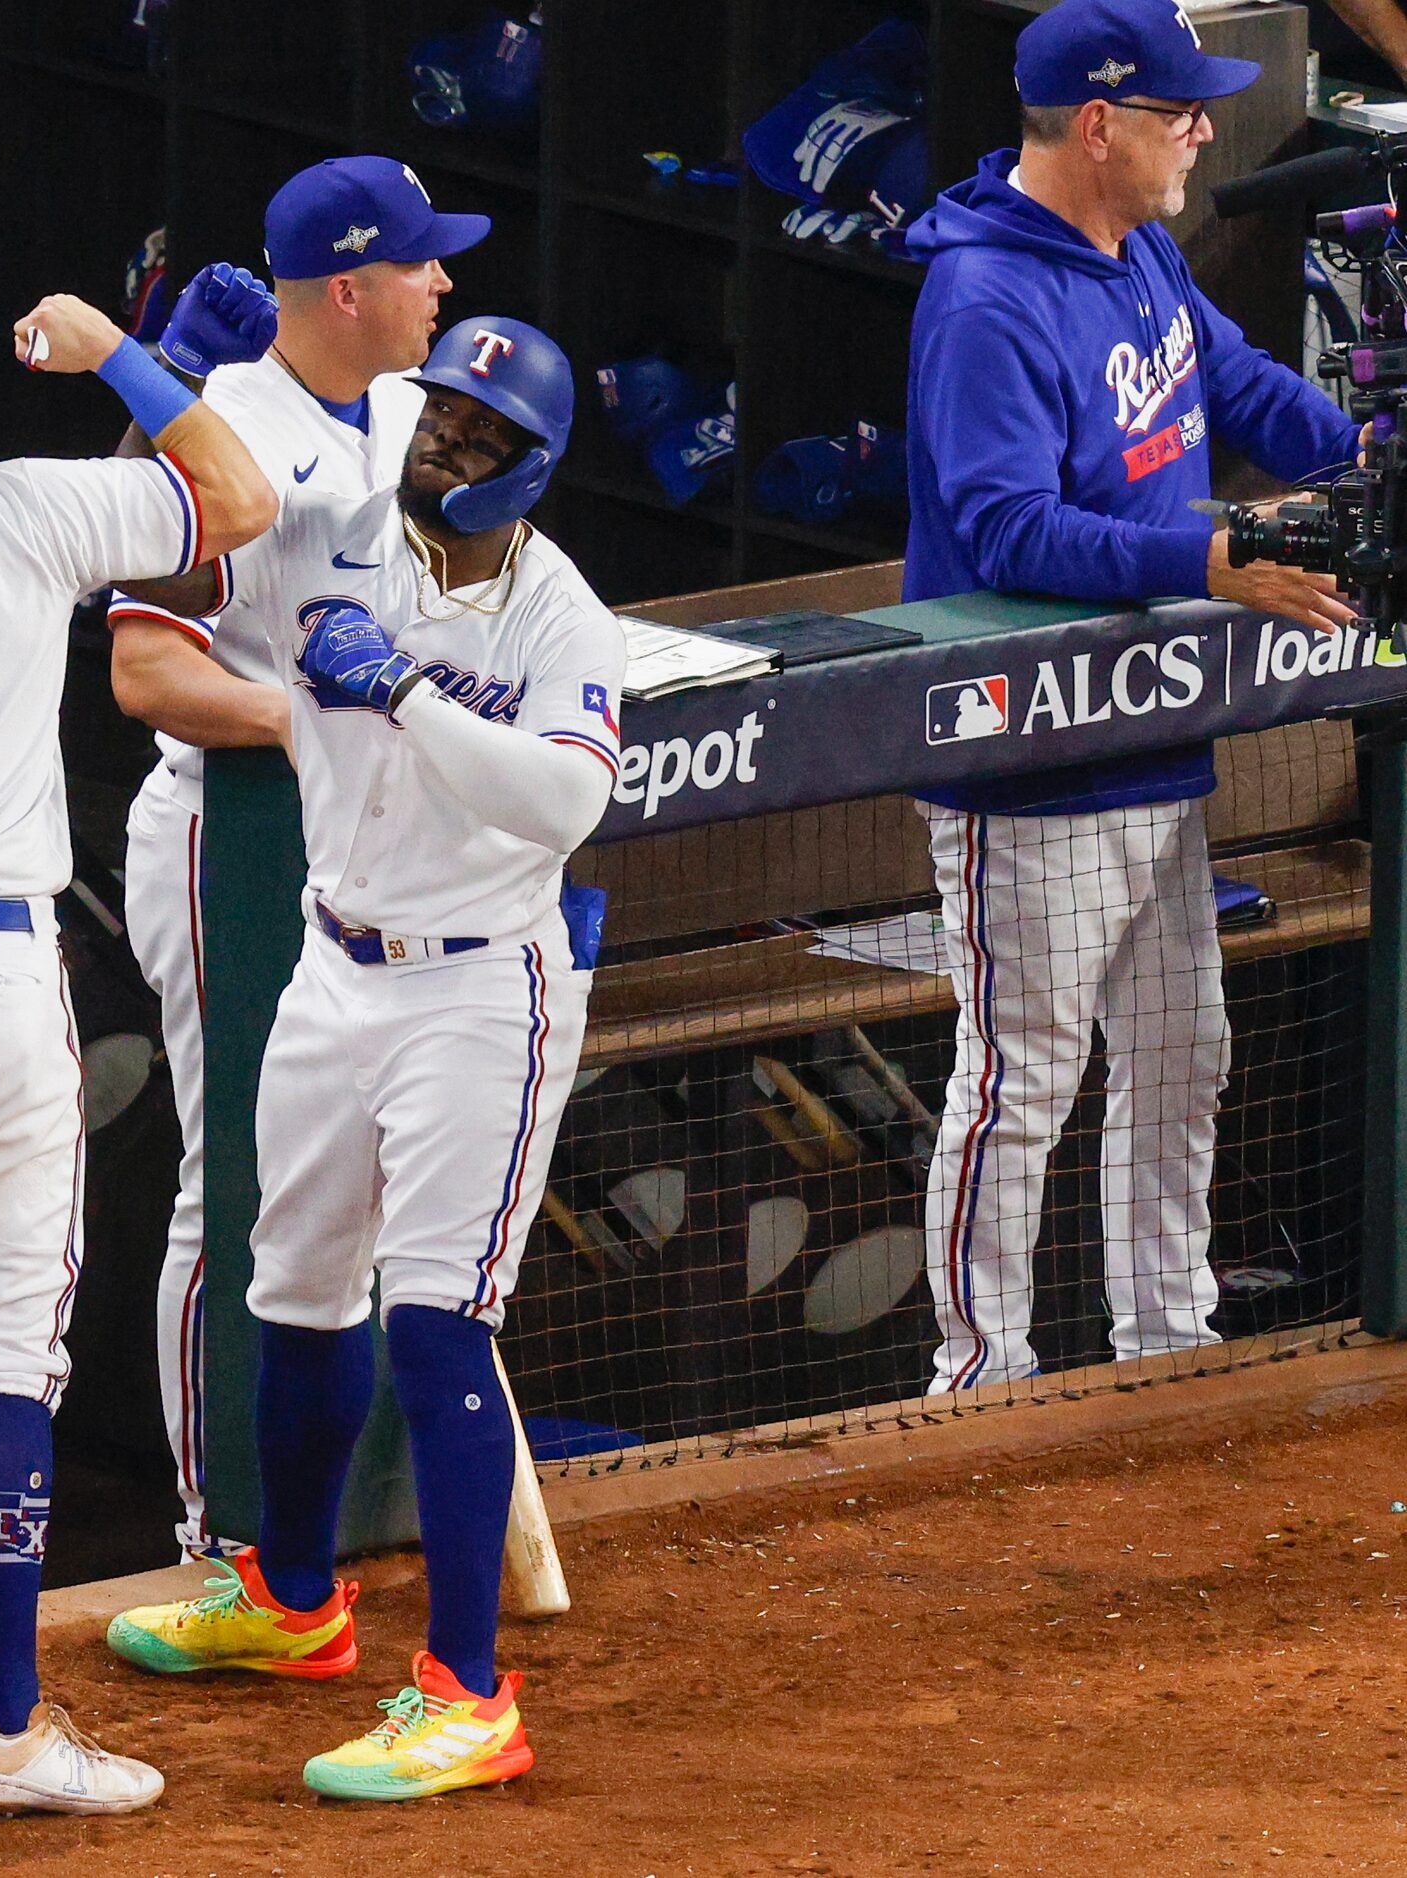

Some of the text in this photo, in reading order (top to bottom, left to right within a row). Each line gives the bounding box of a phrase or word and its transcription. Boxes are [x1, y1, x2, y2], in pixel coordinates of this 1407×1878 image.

[469, 329, 515, 378] T
[1020, 635, 1204, 736] ALCS
[387, 939, 406, 960] 53
